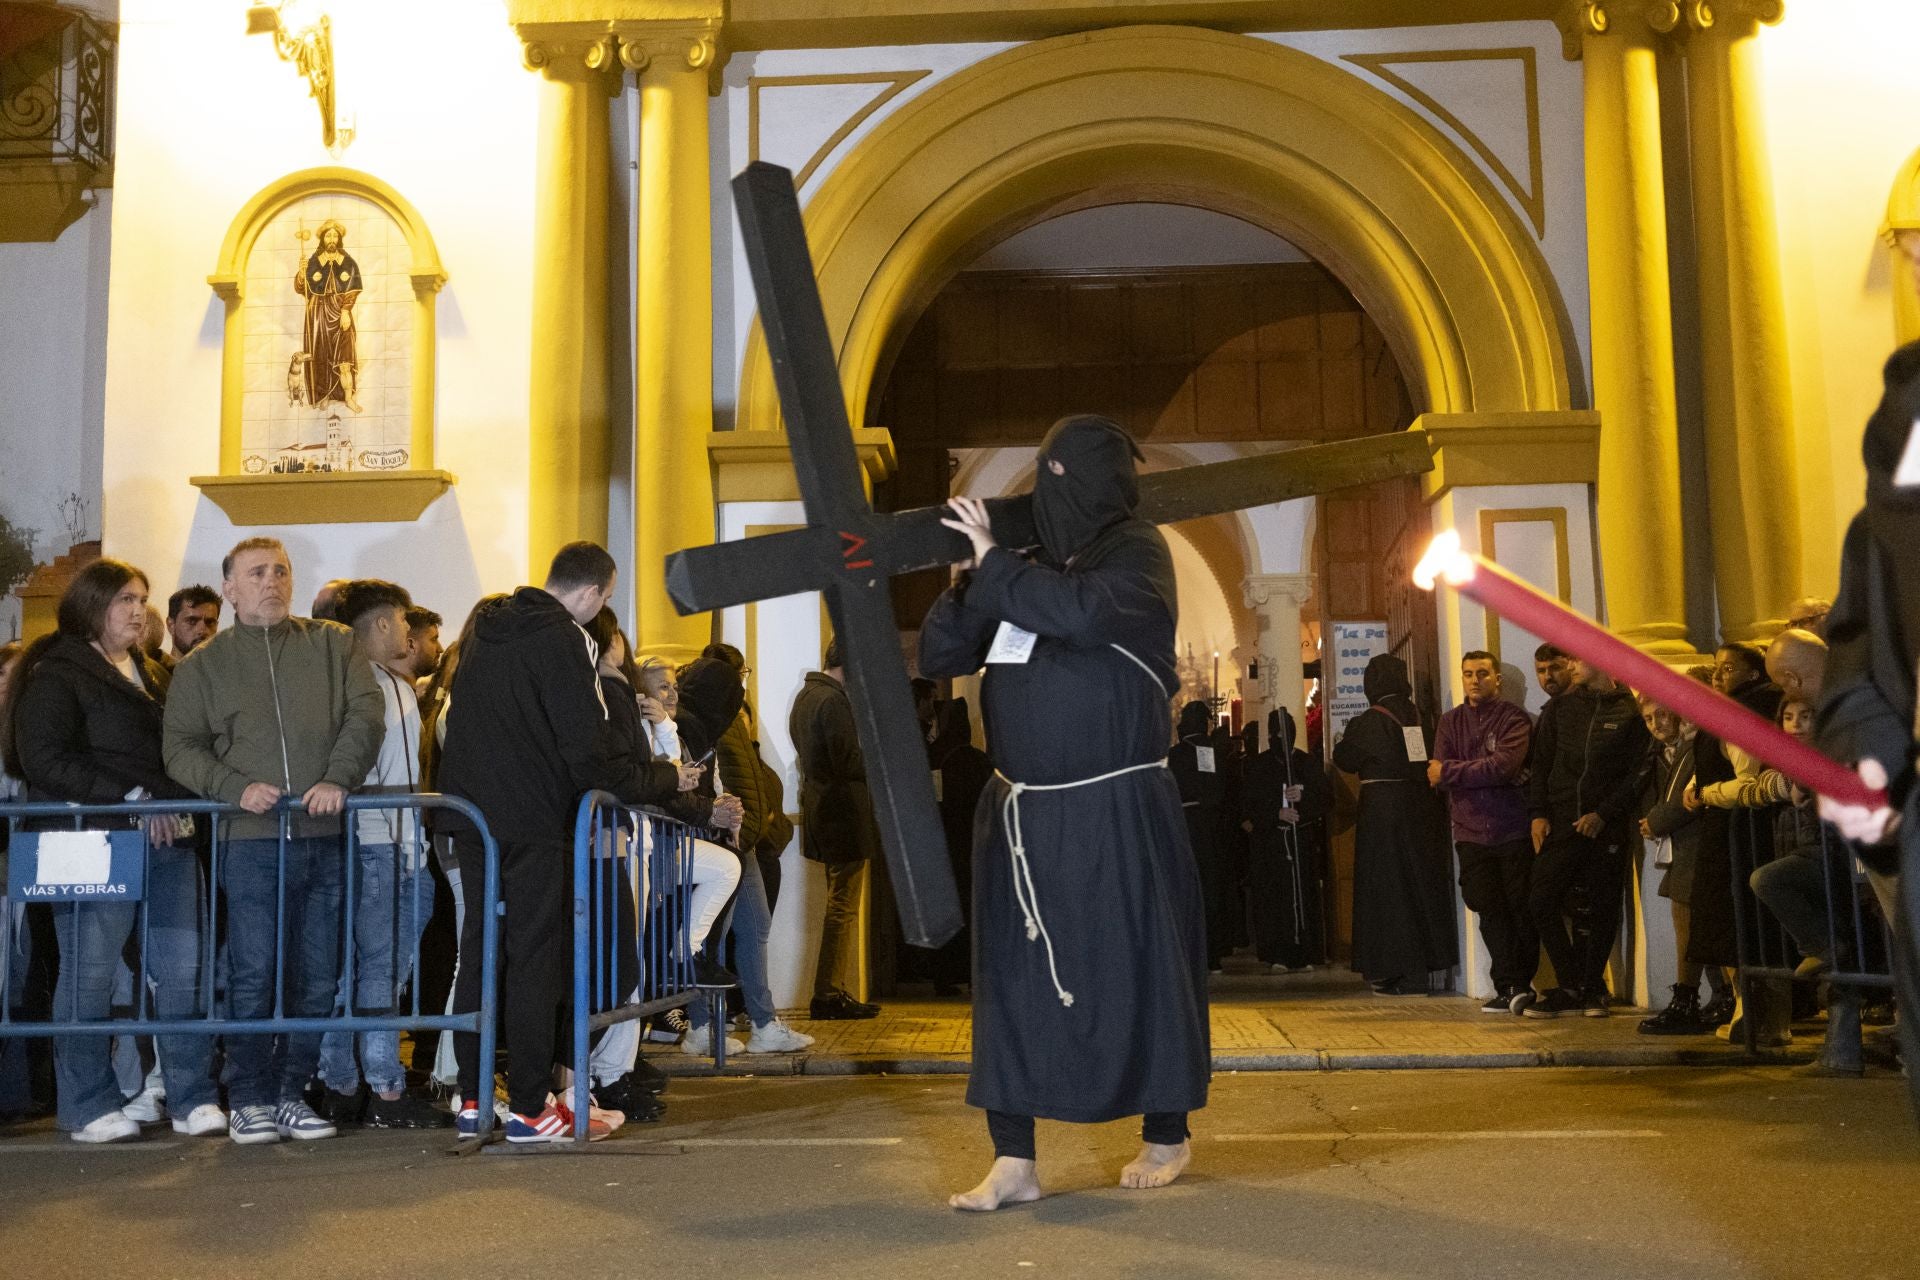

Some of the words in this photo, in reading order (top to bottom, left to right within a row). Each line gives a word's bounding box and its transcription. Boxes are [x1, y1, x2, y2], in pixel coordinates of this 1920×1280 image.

[23, 884, 56, 896] VÍAS
[60, 885, 70, 895] Y
[73, 884, 126, 895] OBRAS
